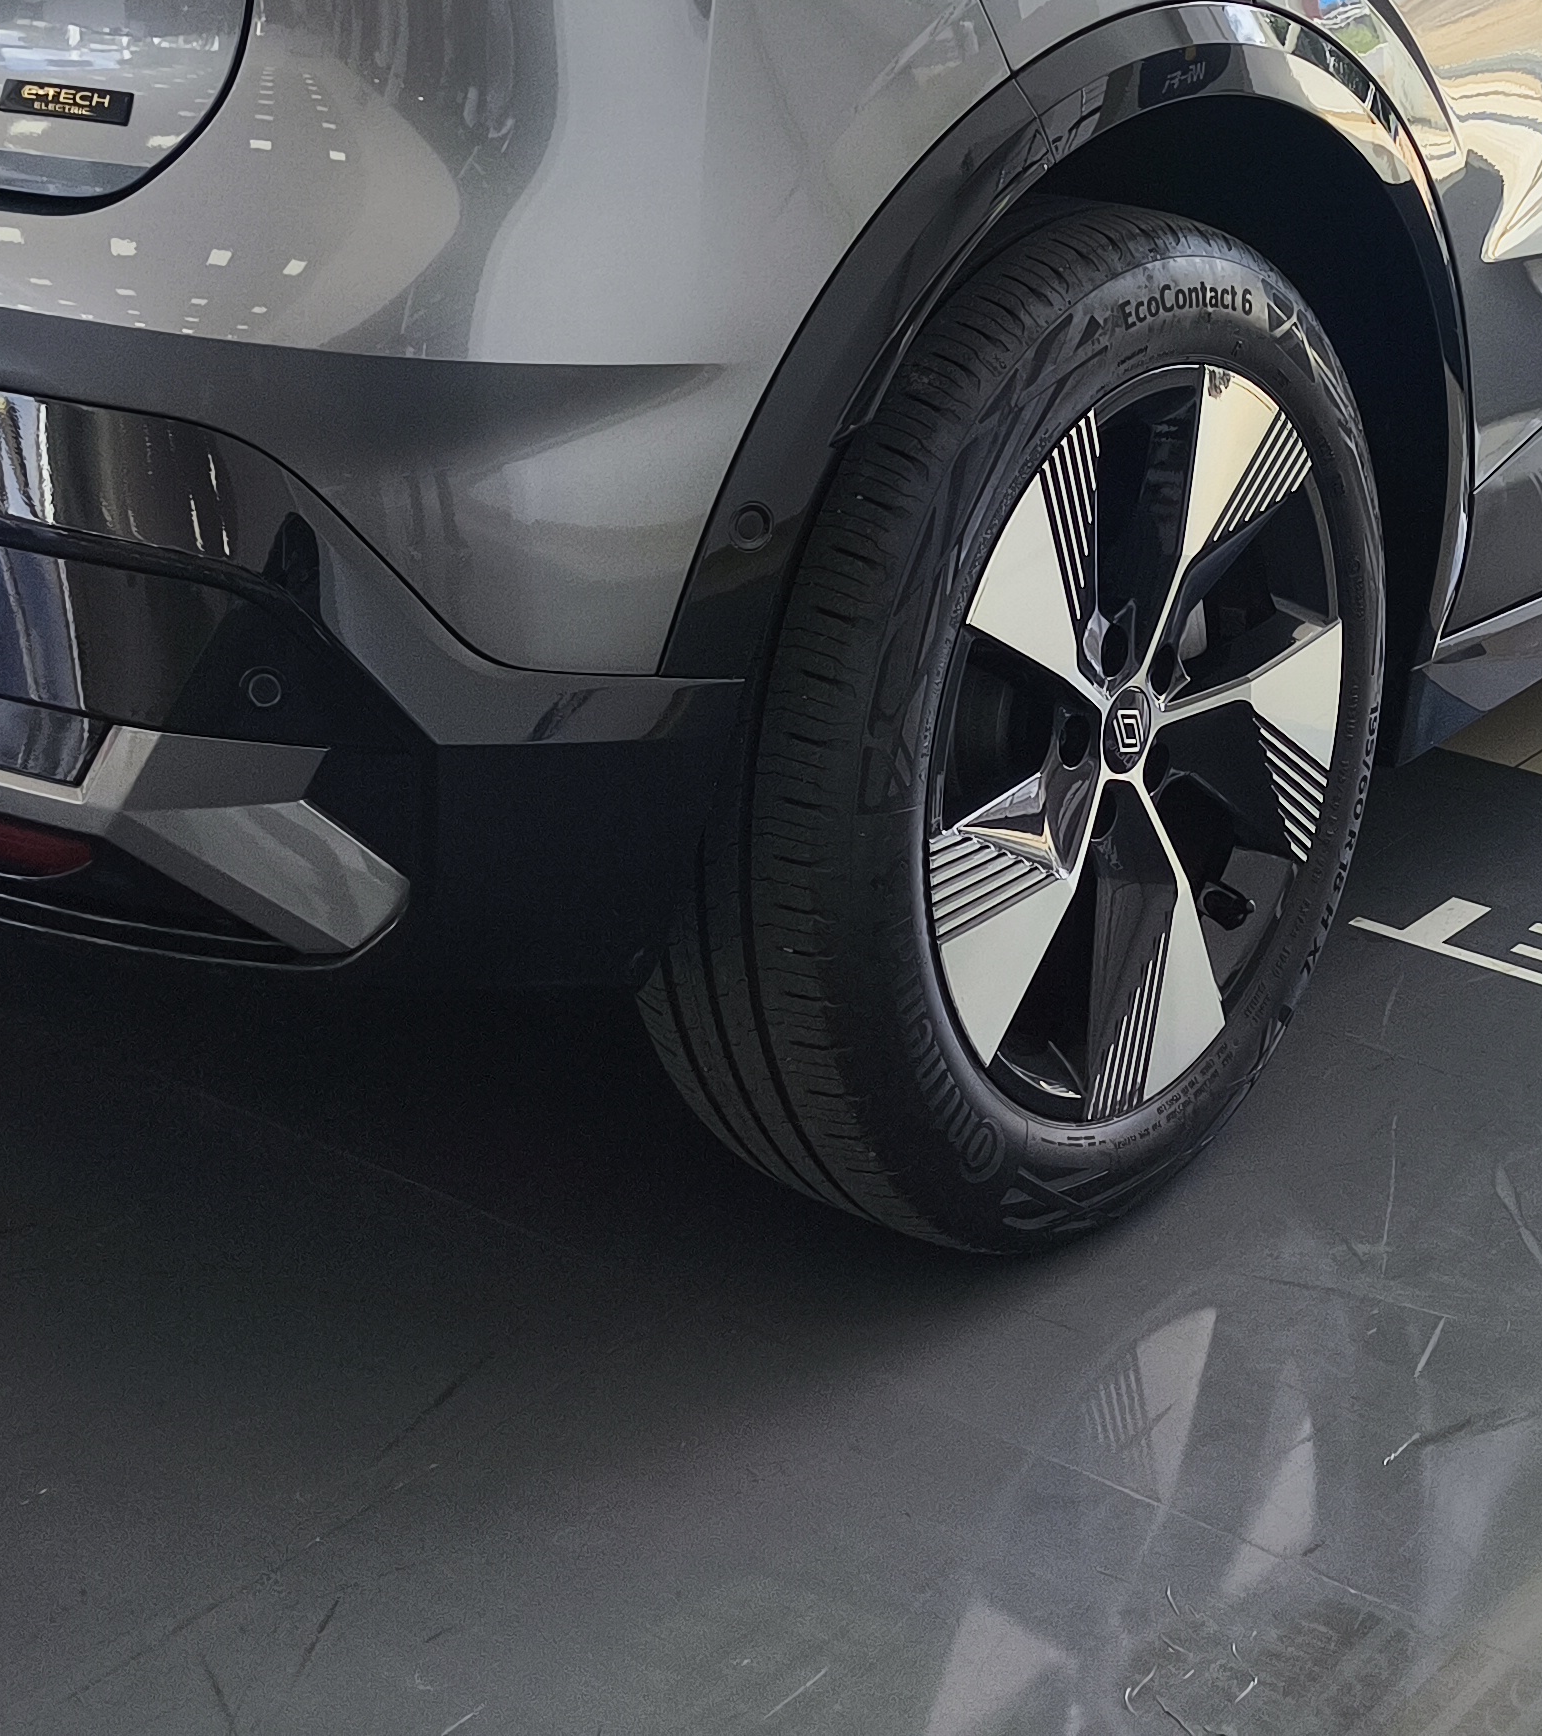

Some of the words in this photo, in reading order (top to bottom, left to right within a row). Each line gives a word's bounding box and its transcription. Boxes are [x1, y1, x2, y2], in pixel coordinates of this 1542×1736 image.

[33, 101, 92, 116] ELECTRIC
[1118, 281, 1238, 331] EcoContact
[1240, 287, 1254, 317] 6
